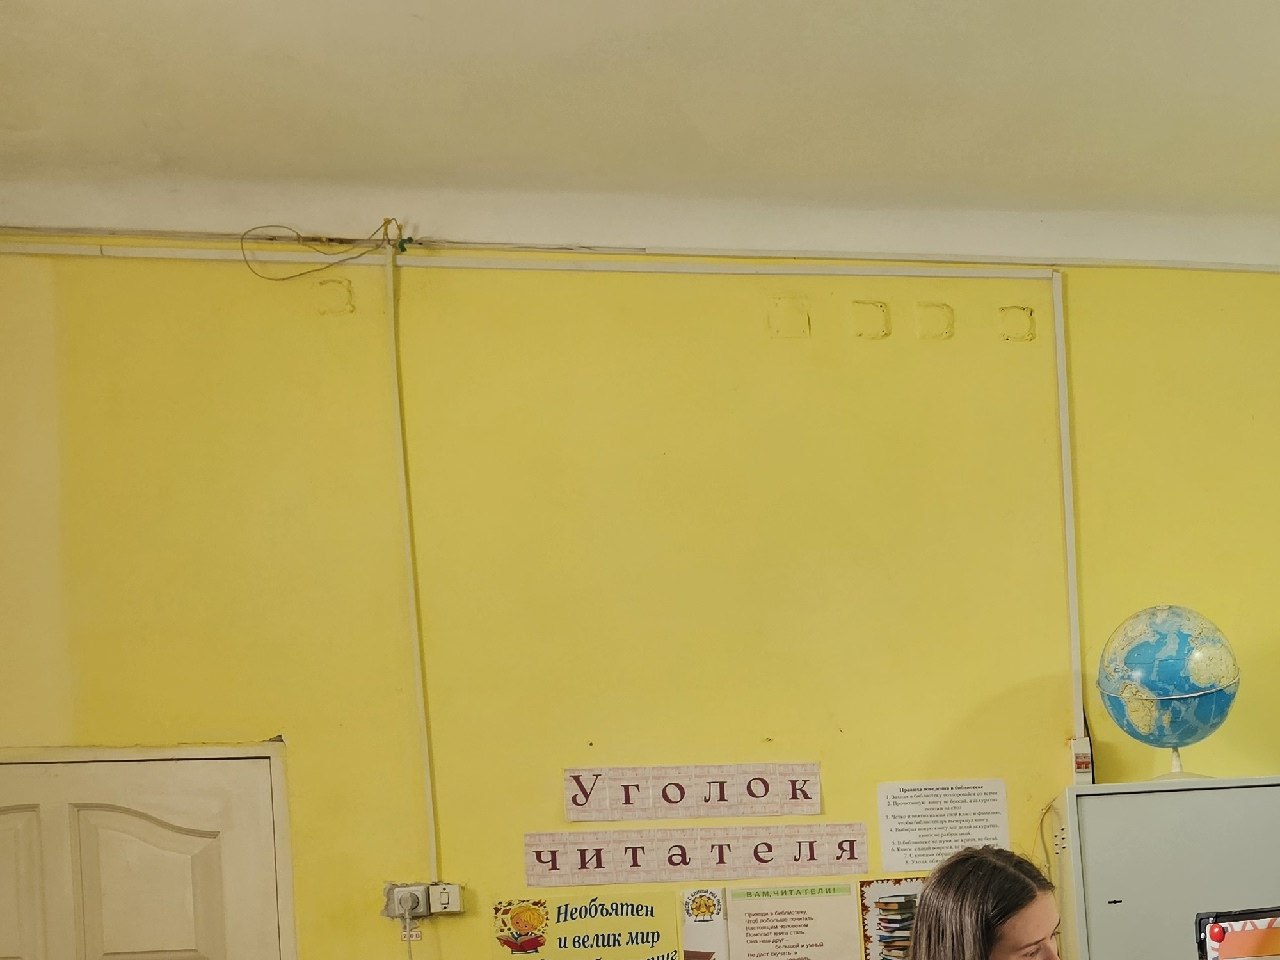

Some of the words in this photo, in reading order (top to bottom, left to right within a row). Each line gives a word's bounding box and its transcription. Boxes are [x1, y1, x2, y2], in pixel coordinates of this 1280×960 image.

[569, 773, 813, 807] Уголок
[532, 838, 859, 872] читателя
[773, 887, 836, 896] ЧИТАТЕЛИ!
[555, 897, 656, 924] Необъятен
[557, 936, 568, 949] и
[572, 931, 622, 949] велик
[625, 930, 661, 949] мир
